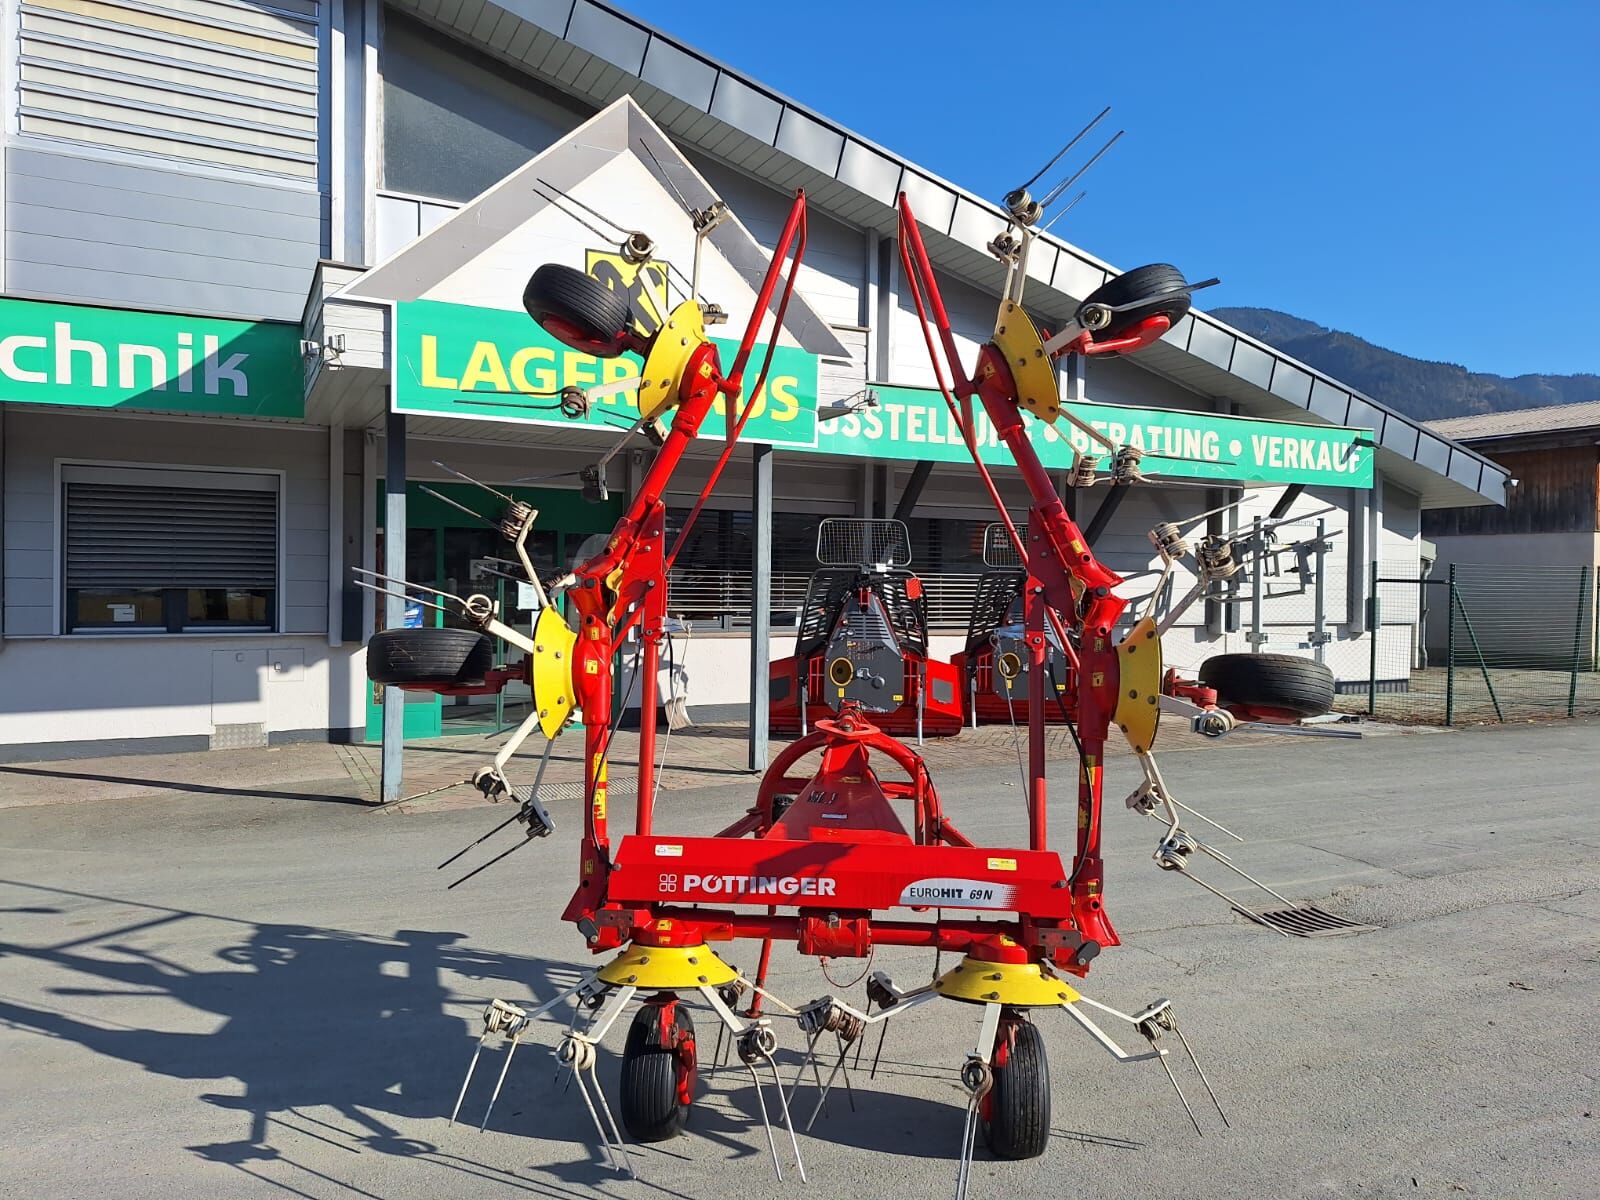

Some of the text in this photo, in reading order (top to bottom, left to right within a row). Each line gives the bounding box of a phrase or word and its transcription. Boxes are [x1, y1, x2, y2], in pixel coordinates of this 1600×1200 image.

[419, 333, 799, 423] LAGERUS
[1252, 433, 1363, 474] VERKAUF
[909, 887, 964, 899] EUROHIT
